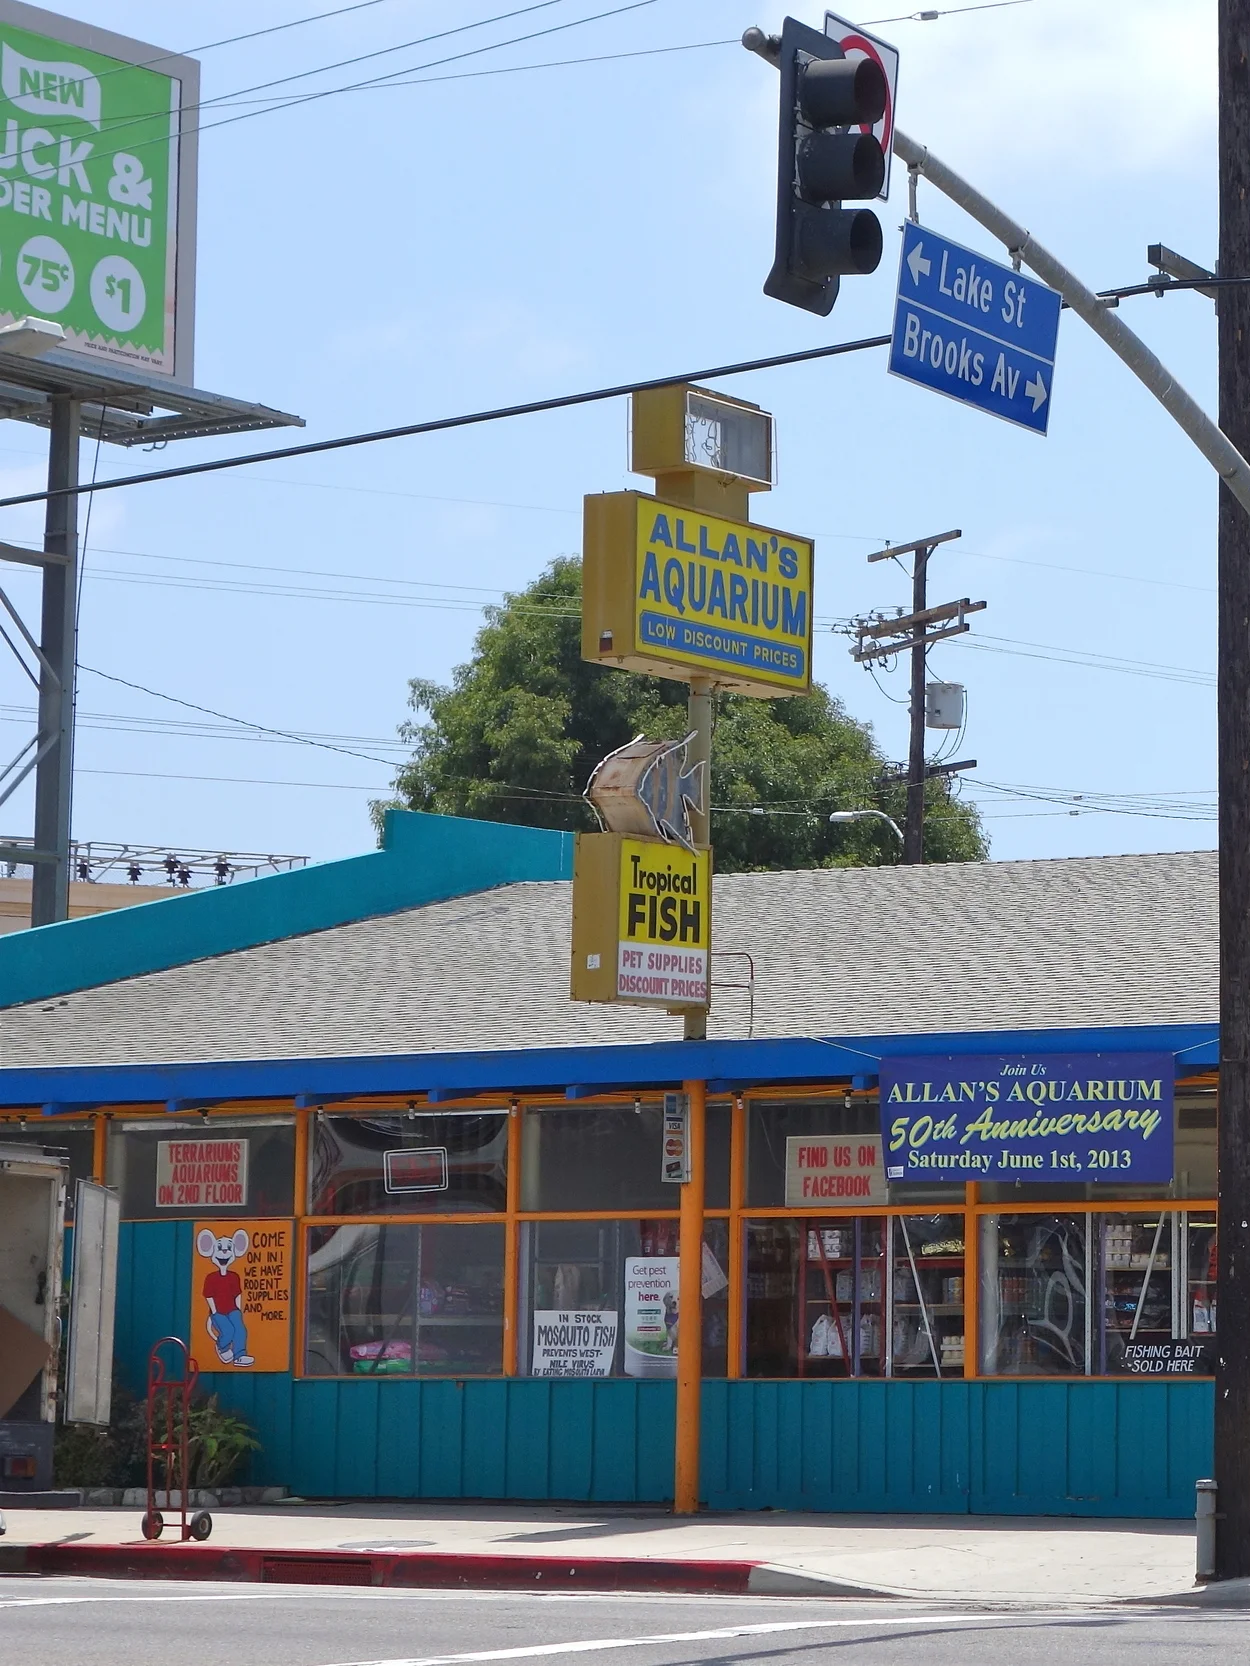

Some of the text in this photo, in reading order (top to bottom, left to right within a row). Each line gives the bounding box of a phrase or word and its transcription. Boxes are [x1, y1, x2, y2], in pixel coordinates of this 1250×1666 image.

[20, 66, 84, 107] NEW
[107, 151, 152, 211] &
[62, 194, 151, 247] MENU
[105, 274, 131, 314] $1
[939, 250, 1026, 328] Lake St
[903, 313, 1020, 400] Brooks Av
[650, 513, 798, 579] ALLAN'S
[640, 551, 806, 637] AQUARIUM
[648, 620, 797, 668] LOW DISCOUNT PRICES
[631, 855, 697, 896] Tropical
[627, 893, 700, 943] FISH
[622, 950, 643, 969] PET
[647, 953, 703, 975] SUPPLIES
[618, 974, 707, 999] DISCOUNT PRICES
[1000, 1064, 1046, 1076] Join Us
[887, 1079, 1162, 1106] ALLAN'S AQUARIUM
[669, 1122, 680, 1130] VISA
[889, 1106, 1162, 1151] 50th Anniversary
[168, 1142, 240, 1163] TERRARIUMS
[798, 1145, 876, 1168] FIND US ON
[908, 1150, 993, 1173] Saturday
[997, 1150, 1044, 1170] June
[1050, 1150, 1082, 1172] 1st,
[1087, 1150, 1131, 1169] 2013
[172, 1164, 238, 1184] AQUARIUMS
[159, 1183, 243, 1205] ON 2ND FLOOR
[803, 1175, 871, 1197] FACEBOOK
[252, 1232, 286, 1249] COME
[247, 1251, 261, 1263] ON
[244, 1265, 283, 1277] WE HAVE
[633, 1265, 666, 1277] Get pest
[244, 1278, 282, 1290] RODENT
[628, 1279, 671, 1290] prevention
[247, 1290, 289, 1302] SUPPLIES
[244, 1303, 262, 1313] AND
[261, 1311, 287, 1321] MORE.
[559, 1314, 602, 1324] IN STOCK
[537, 1325, 616, 1347] MOSQUITO FISH
[542, 1348, 577, 1358] PREVENTS
[1125, 1345, 1205, 1358] FISHING BAIT
[550, 1360, 595, 1369] NILE VIRUS
[1131, 1359, 1195, 1373] SOLD HERE
